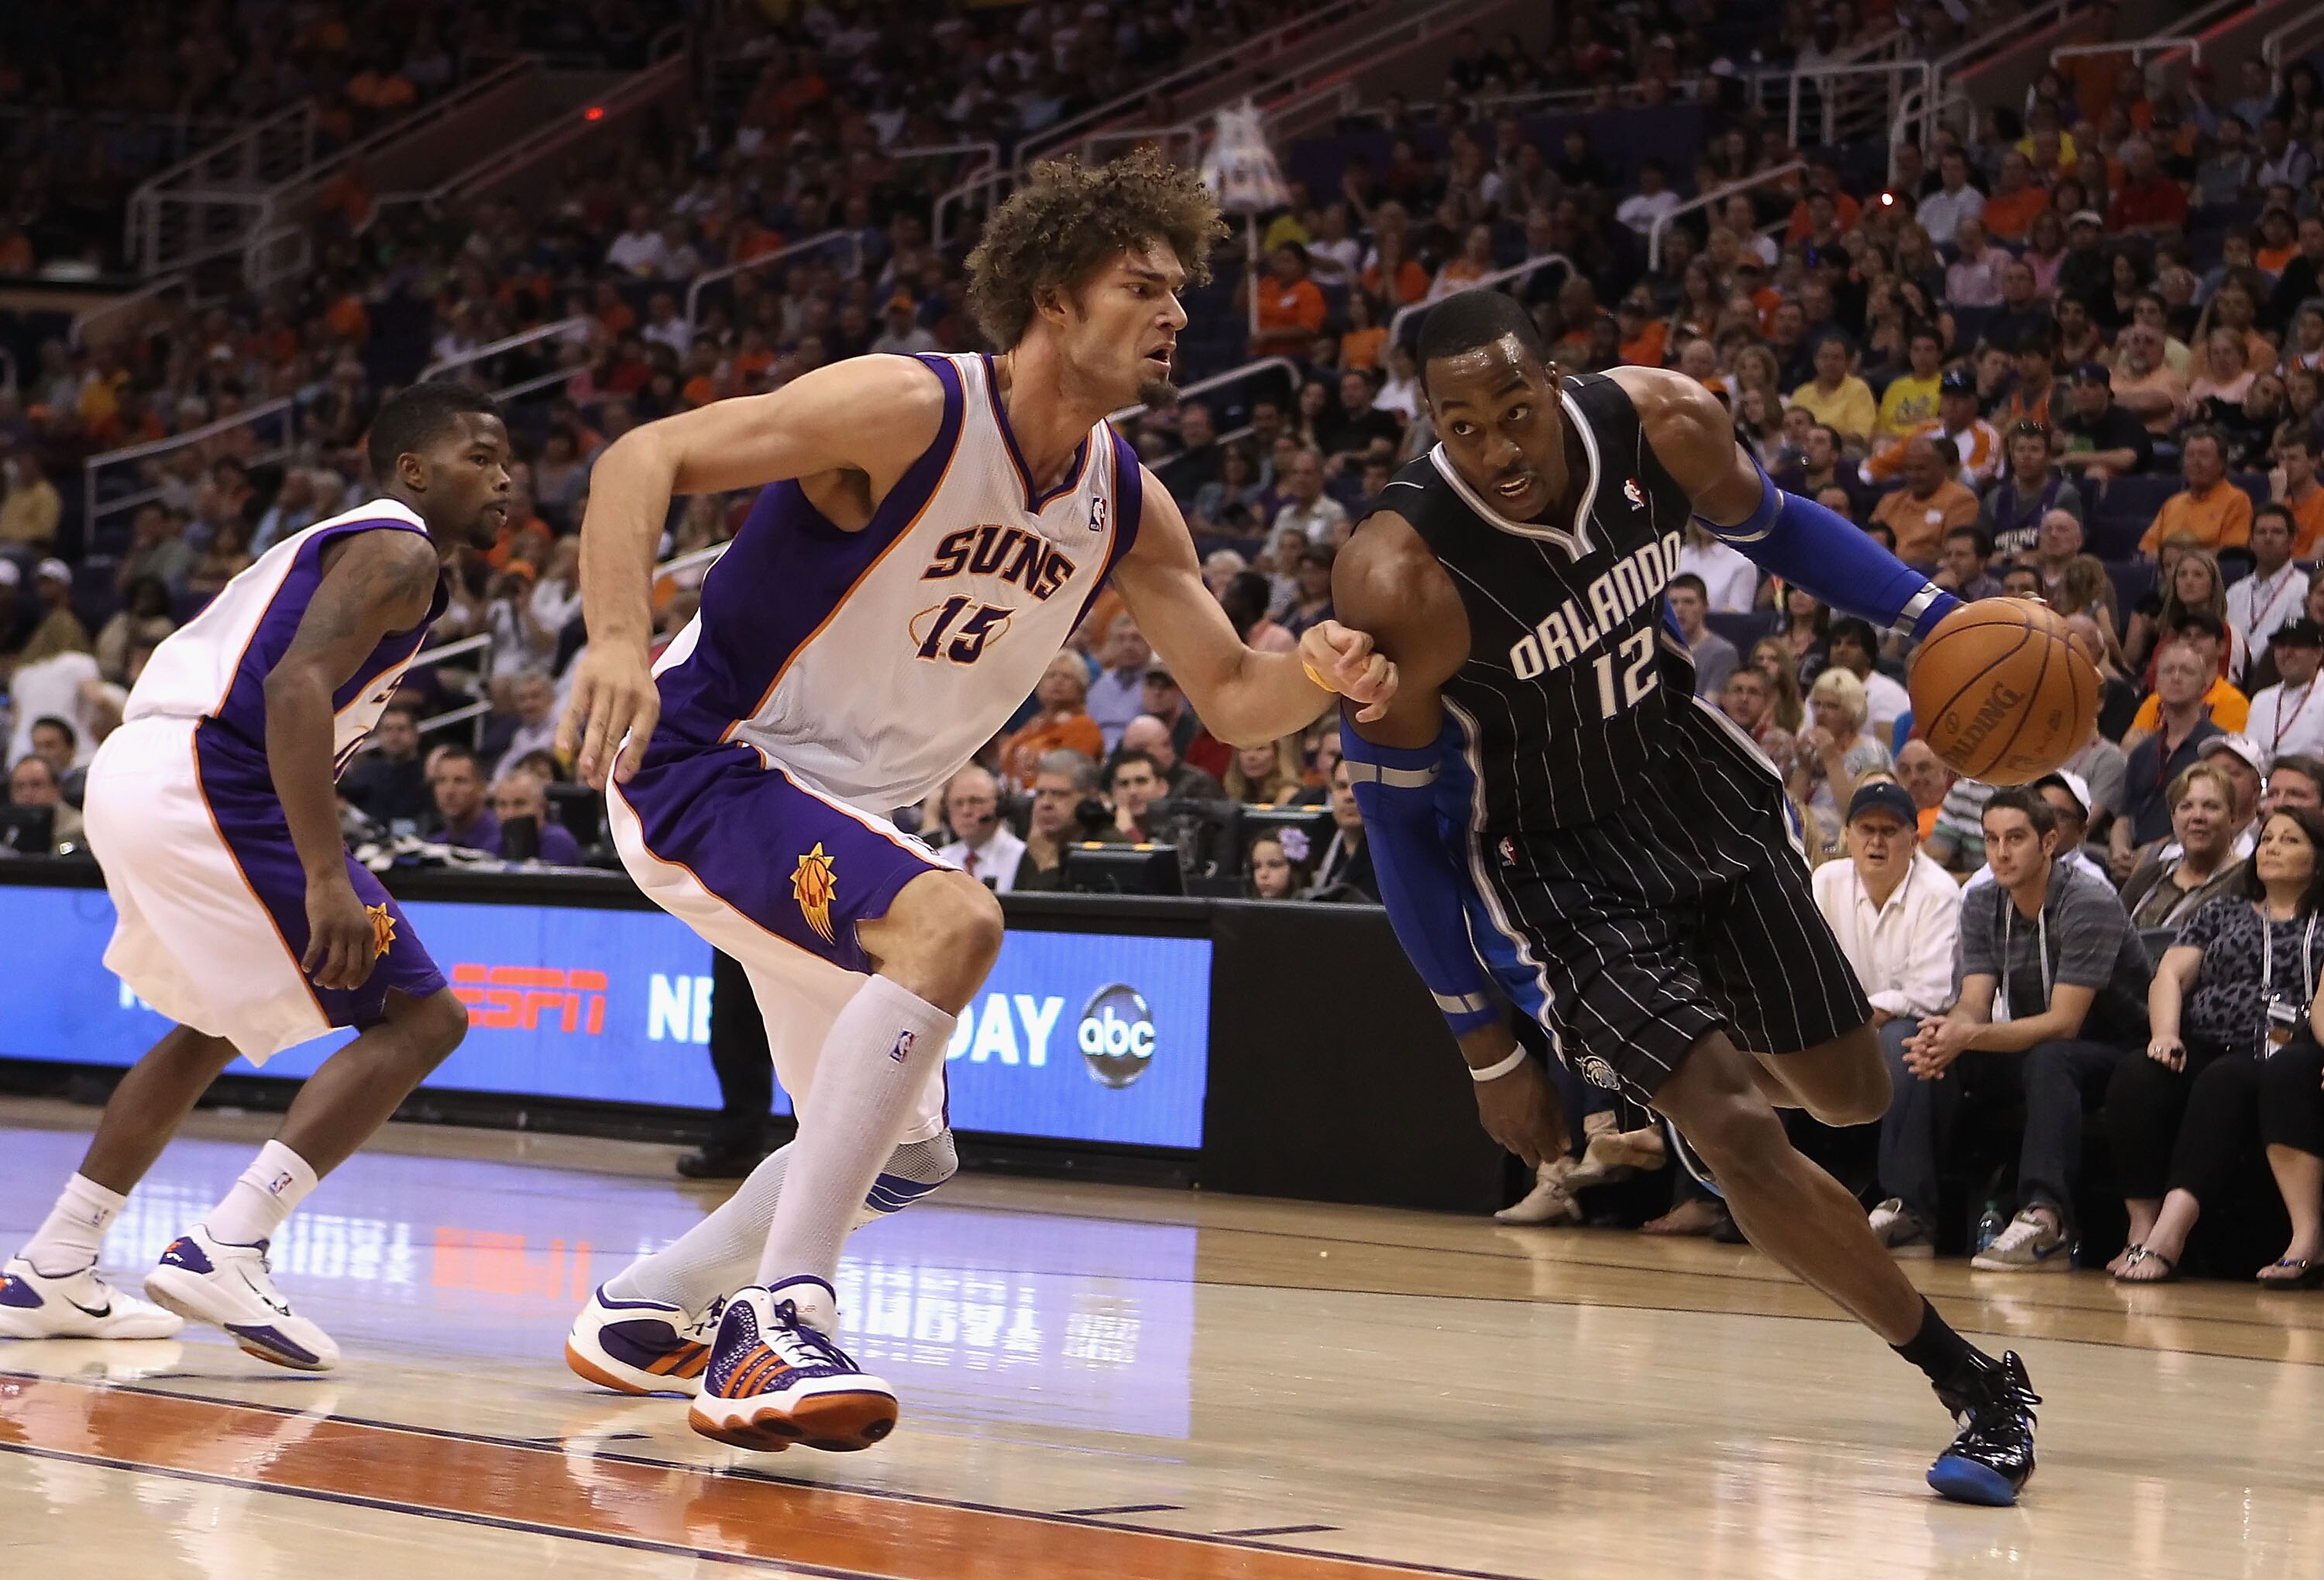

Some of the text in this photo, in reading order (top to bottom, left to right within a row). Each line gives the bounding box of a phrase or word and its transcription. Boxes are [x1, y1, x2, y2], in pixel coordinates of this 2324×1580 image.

[920, 524, 1077, 602] SUNS
[1509, 530, 1681, 681] ORLANDO
[915, 594, 1017, 666] 15
[1592, 626, 1659, 720] 12
[1941, 681, 2026, 769] PALDING
[451, 963, 608, 1036] ESPN
[1078, 1005, 1156, 1059] abc
